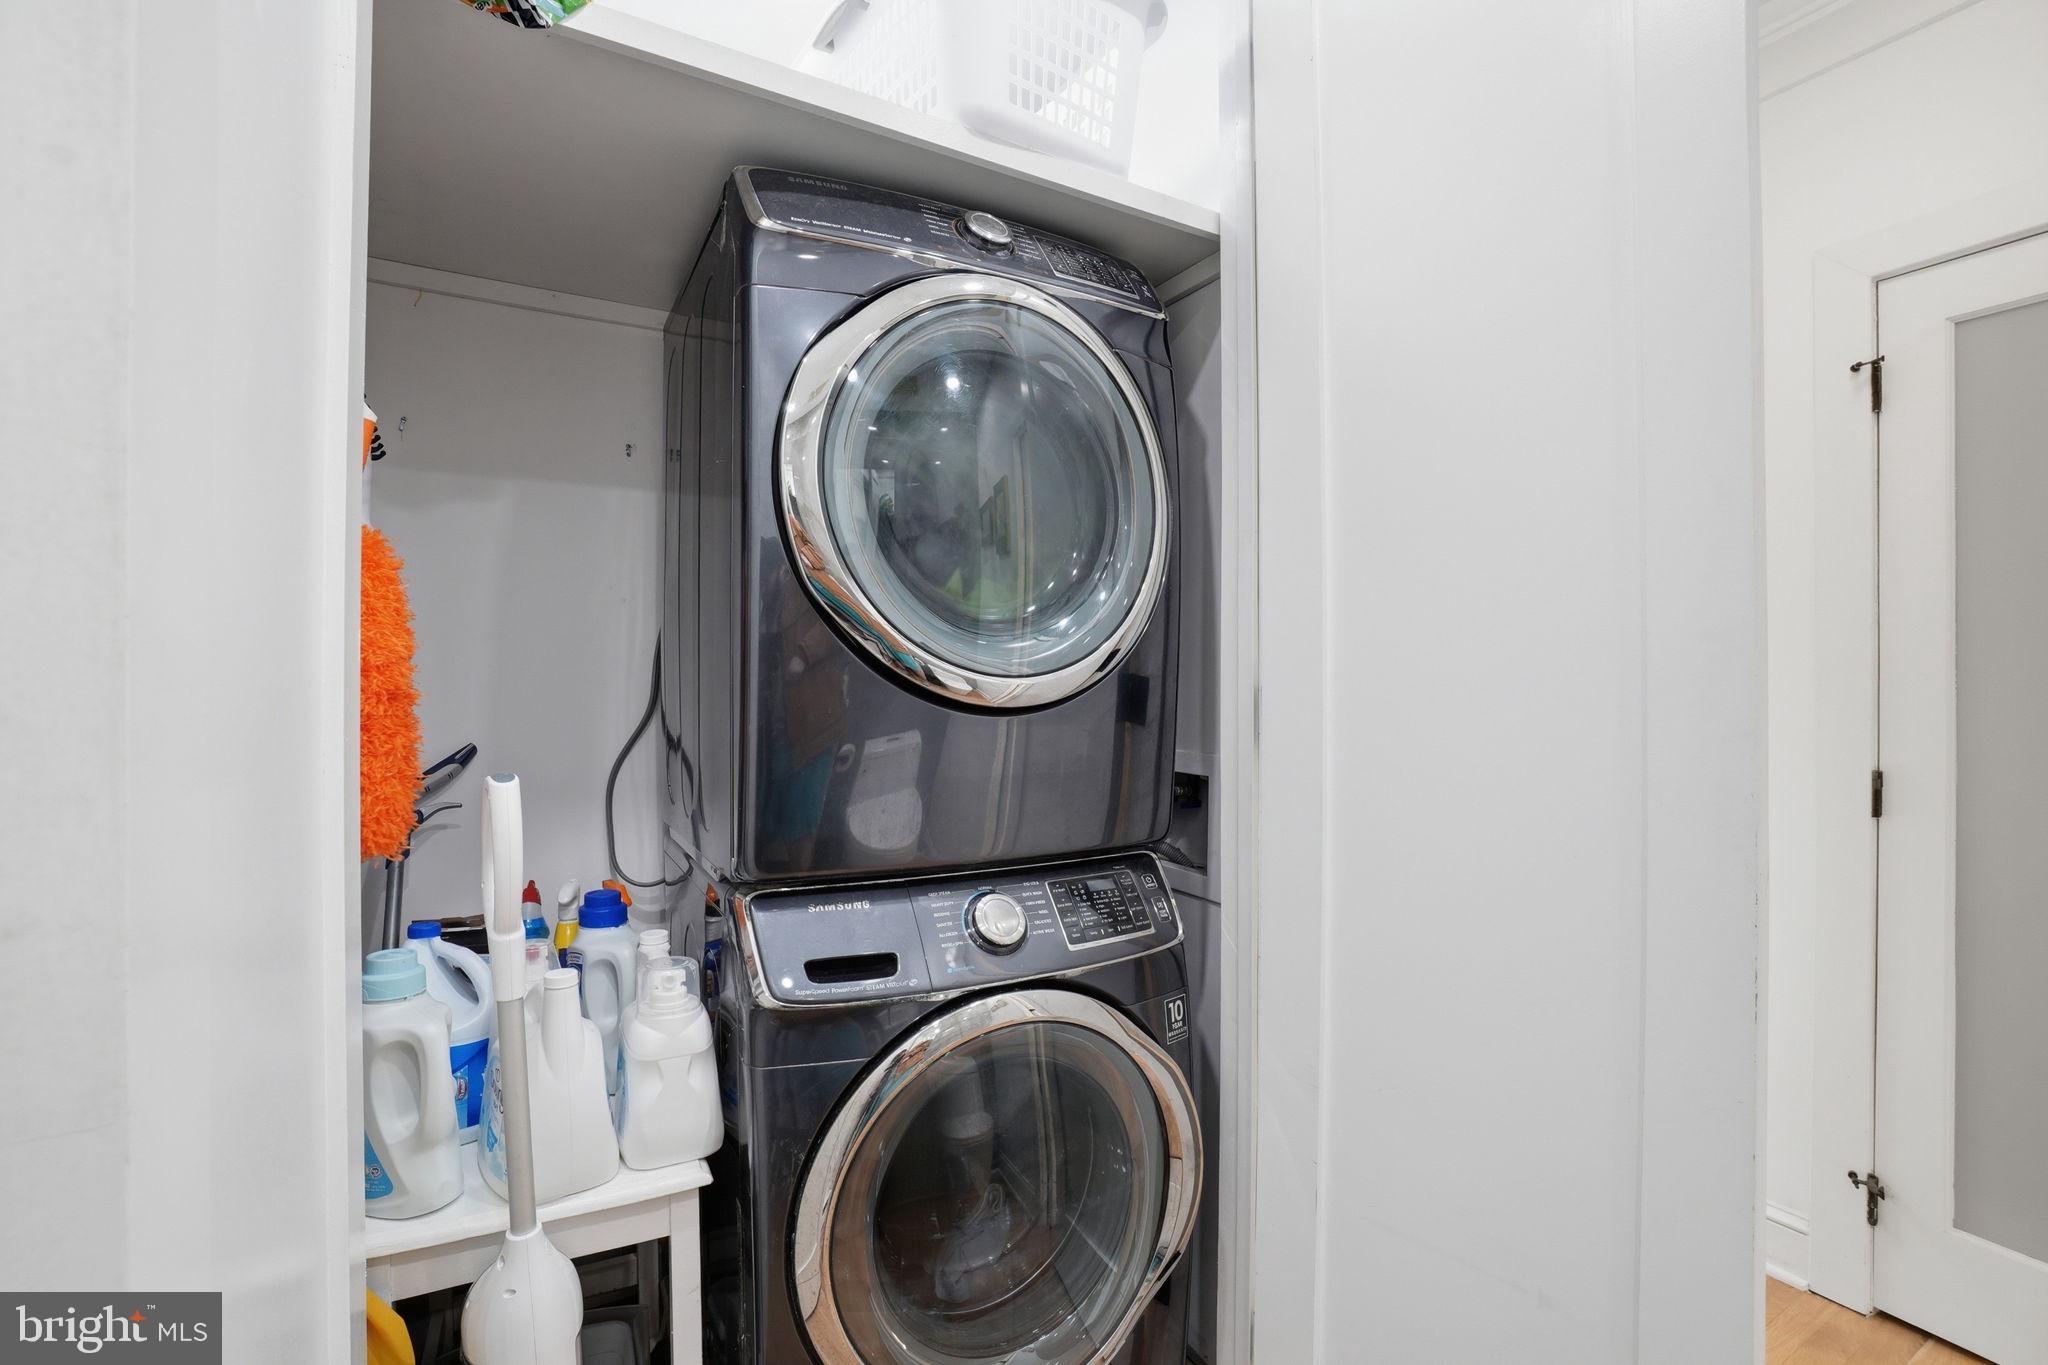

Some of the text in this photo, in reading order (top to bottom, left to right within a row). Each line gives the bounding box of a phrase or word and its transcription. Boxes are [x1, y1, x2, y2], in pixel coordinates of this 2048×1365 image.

[788, 176, 848, 191] SAMSUNG
[808, 900, 870, 913] SAMSUNG
[865, 983, 886, 991] STEAM
[1168, 1000, 1183, 1023] 10
[1172, 1021, 1183, 1030] YEAR
